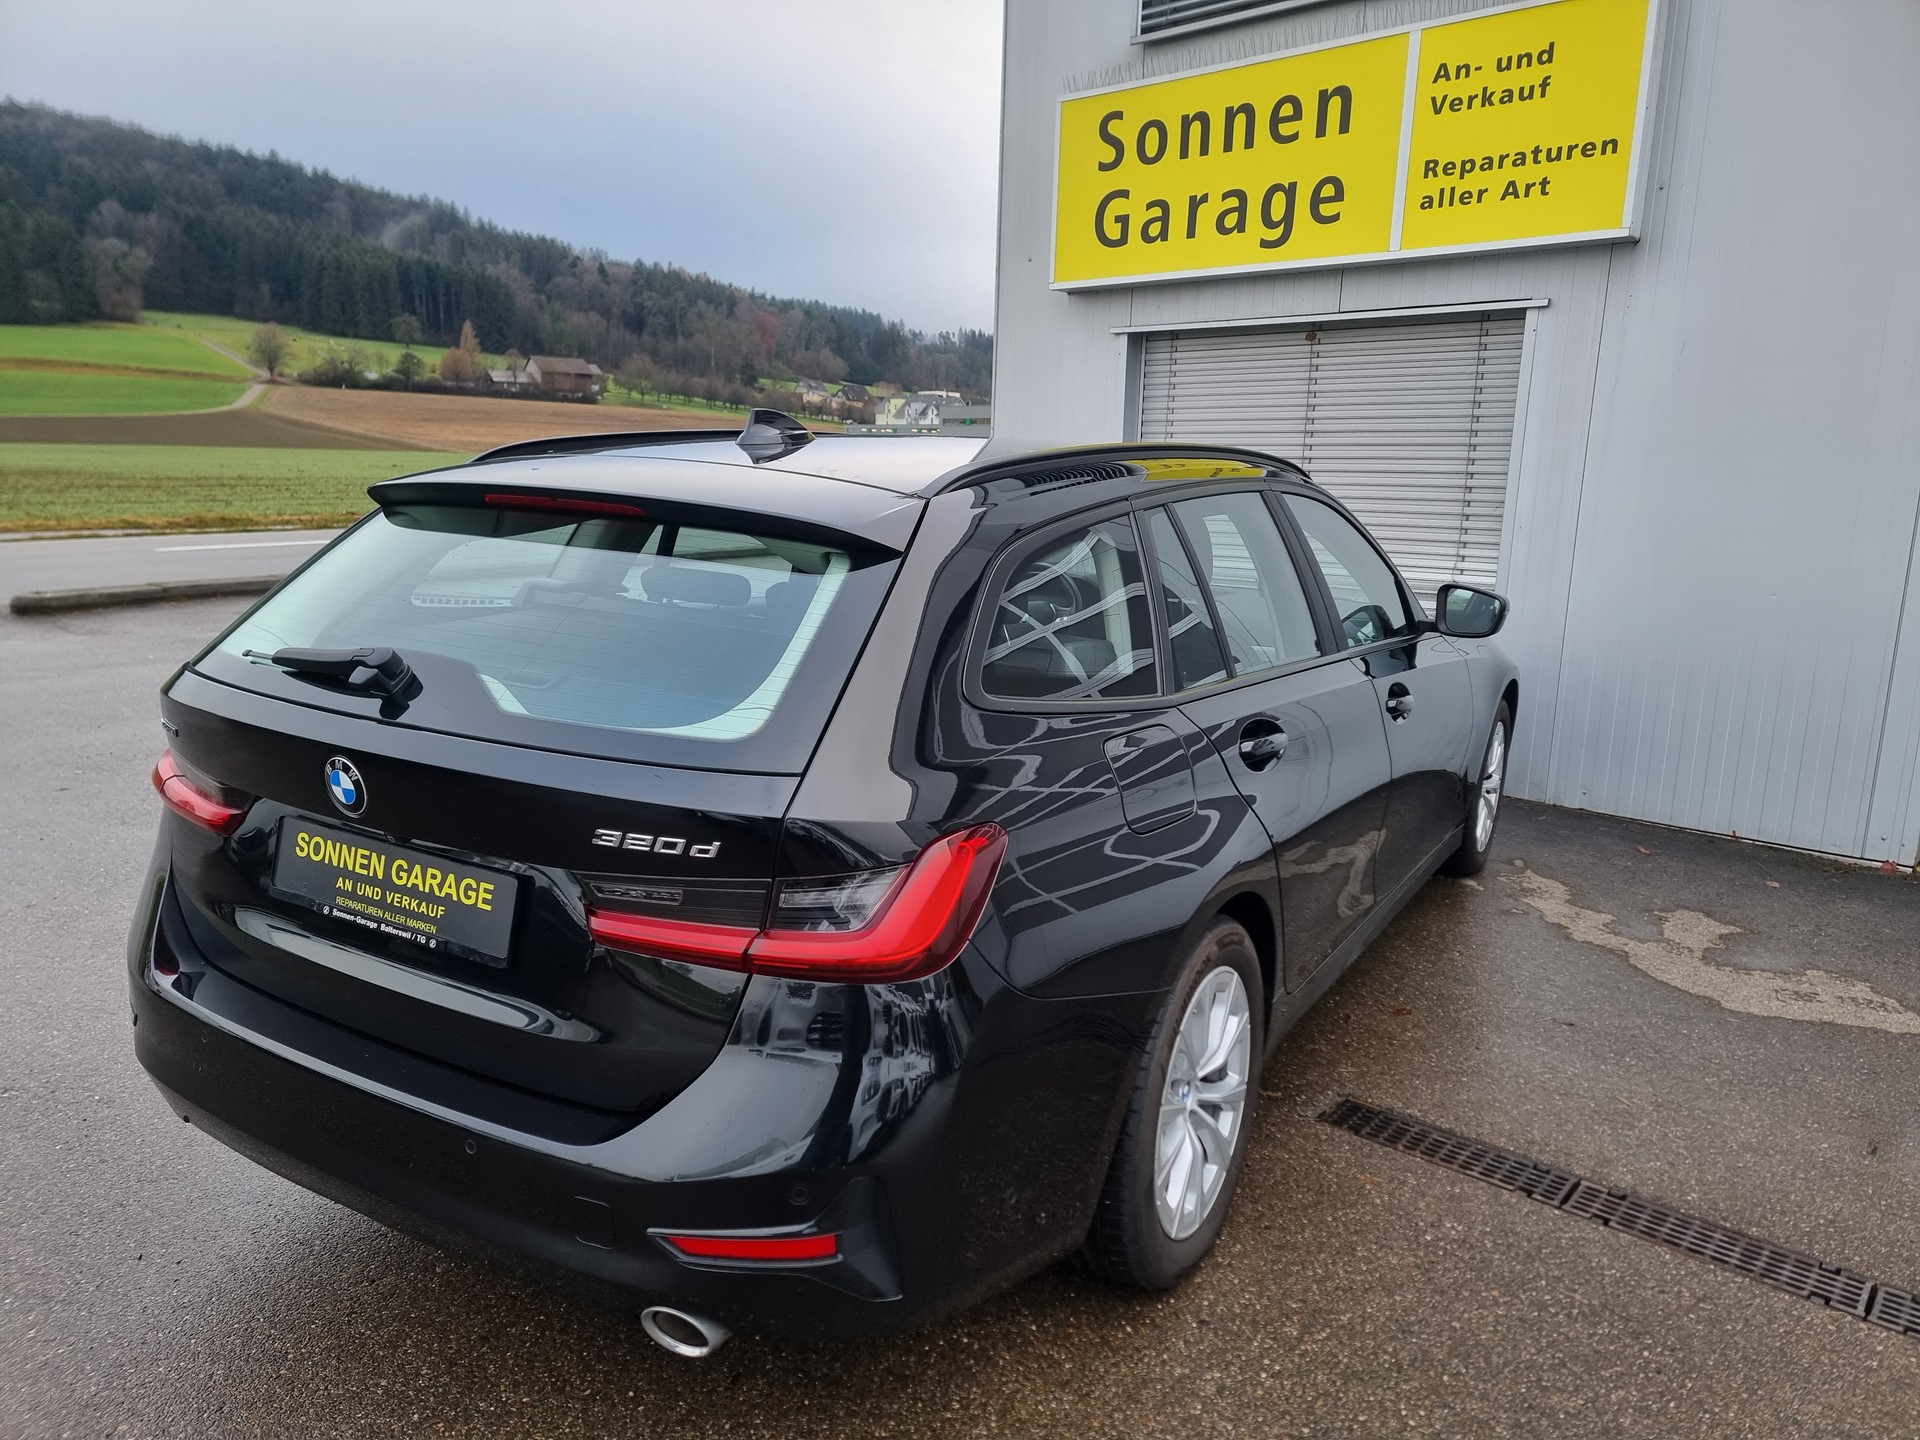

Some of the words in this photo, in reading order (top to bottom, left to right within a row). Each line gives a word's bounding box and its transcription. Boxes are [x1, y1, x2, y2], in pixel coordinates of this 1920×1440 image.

[1431, 62, 1483, 85] An-
[1496, 42, 1556, 73] und
[1430, 75, 1552, 116] Verkauf
[1097, 84, 1353, 173] Sonnen
[1423, 138, 1619, 181] Reparaturen
[1094, 175, 1345, 250] Garage
[1419, 185, 1489, 211] aller
[1499, 175, 1551, 201] Art
[325, 759, 359, 782] BMW
[295, 831, 387, 881] SONNEN
[390, 858, 496, 911] GARAGE
[335, 877, 354, 893] AN
[356, 882, 383, 901] UND
[386, 891, 447, 919] VERKAUF
[335, 896, 384, 918] REPARATUREN
[383, 911, 406, 925] ALLER
[406, 917, 438, 934] MARKEN
[332, 908, 379, 930] Sonnen-Garage
[416, 934, 427, 945] TG
